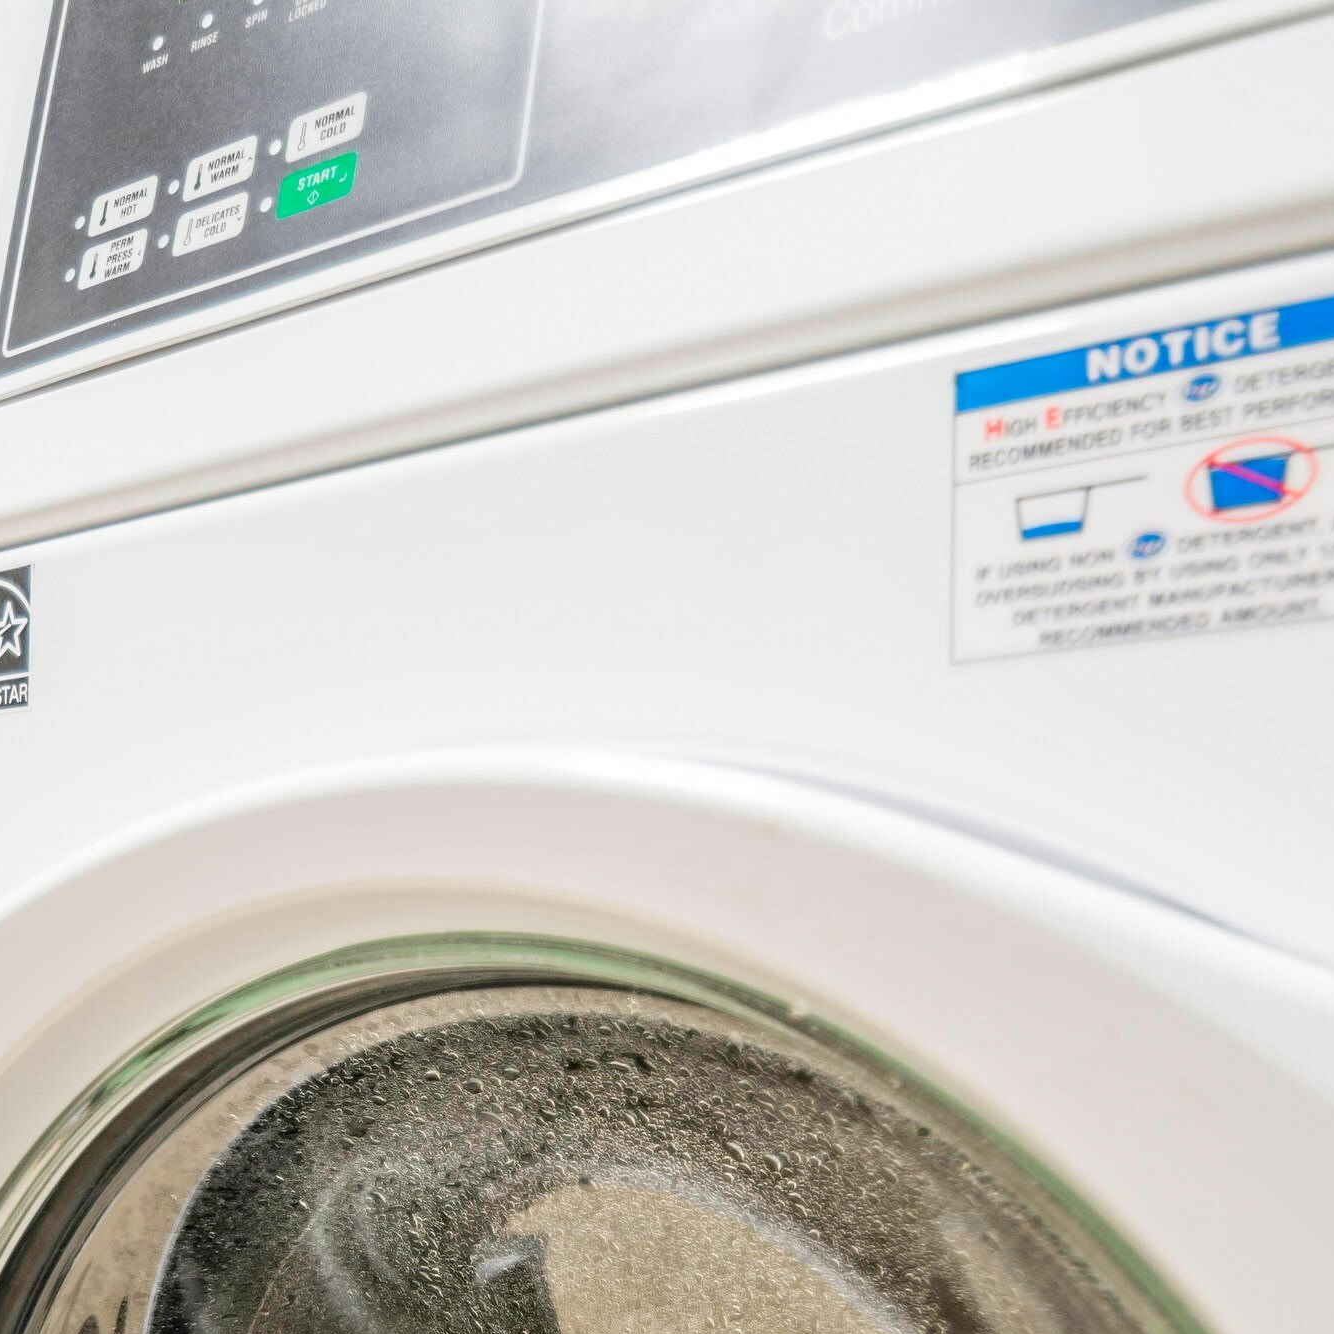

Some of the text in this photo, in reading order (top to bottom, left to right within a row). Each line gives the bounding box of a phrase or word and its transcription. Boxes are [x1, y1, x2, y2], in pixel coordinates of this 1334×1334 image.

[245, 9, 268, 28] SPIN
[288, 0, 328, 23] LOCKED
[190, 31, 218, 53] RINSE
[142, 54, 169, 74] WASH
[314, 105, 356, 130] NORMAL
[320, 122, 347, 142] COLD
[208, 149, 246, 173] NORMAL
[210, 164, 240, 184] WARM
[297, 165, 339, 191] START
[113, 187, 149, 208] NORMAL
[120, 203, 139, 218] HOT
[195, 204, 241, 229] DELICATES
[204, 222, 227, 239] COLD
[110, 235, 135, 253] PERM
[106, 248, 134, 266] PRESS
[104, 261, 131, 280] WARM
[1086, 310, 1282, 383] NOTICE
[969, 428, 1123, 472] RECOMMENDED
[1130, 417, 1173, 441] FOR
[1180, 407, 1234, 433] BEST
